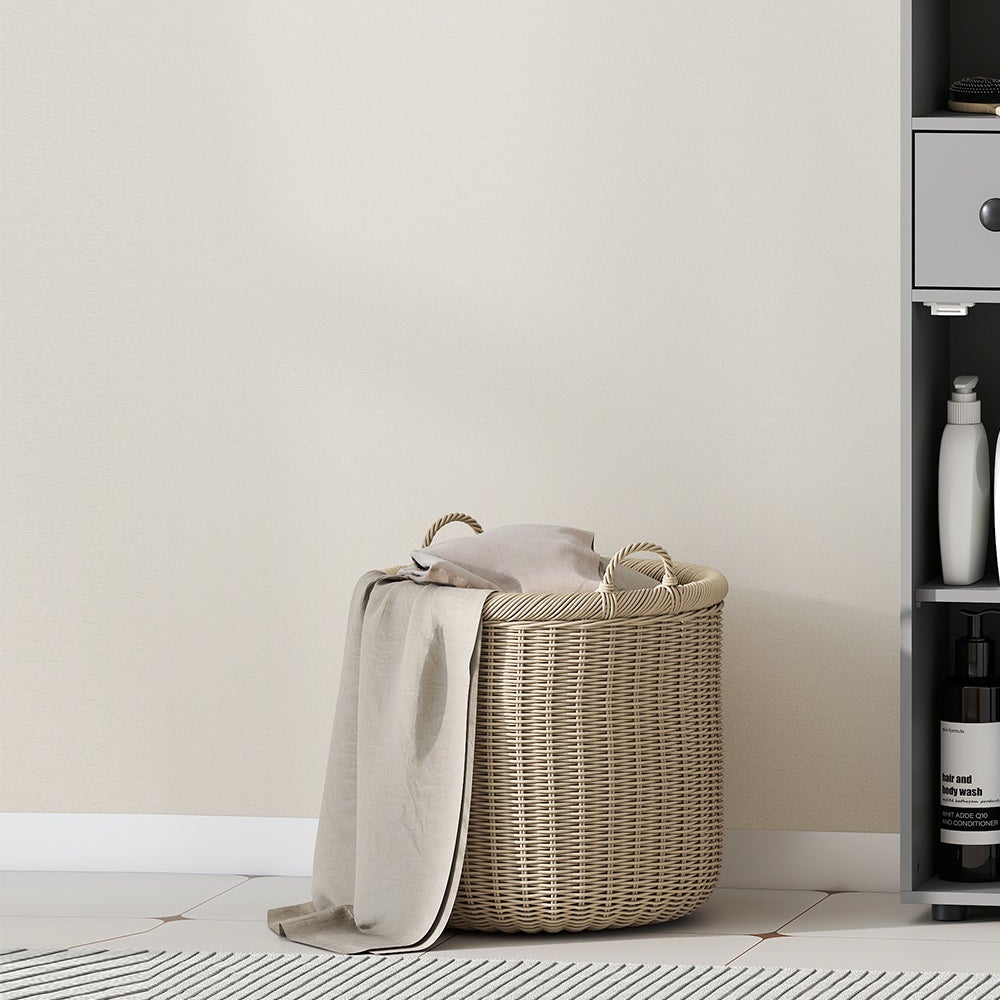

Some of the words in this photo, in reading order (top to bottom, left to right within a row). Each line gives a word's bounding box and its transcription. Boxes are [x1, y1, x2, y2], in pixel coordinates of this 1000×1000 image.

[942, 772, 955, 783] hair
[955, 774, 972, 784] and
[942, 784, 958, 796] body
[959, 787, 983, 797] wash
[942, 818, 953, 826] AND
[953, 819, 998, 827] CONDITIONER
